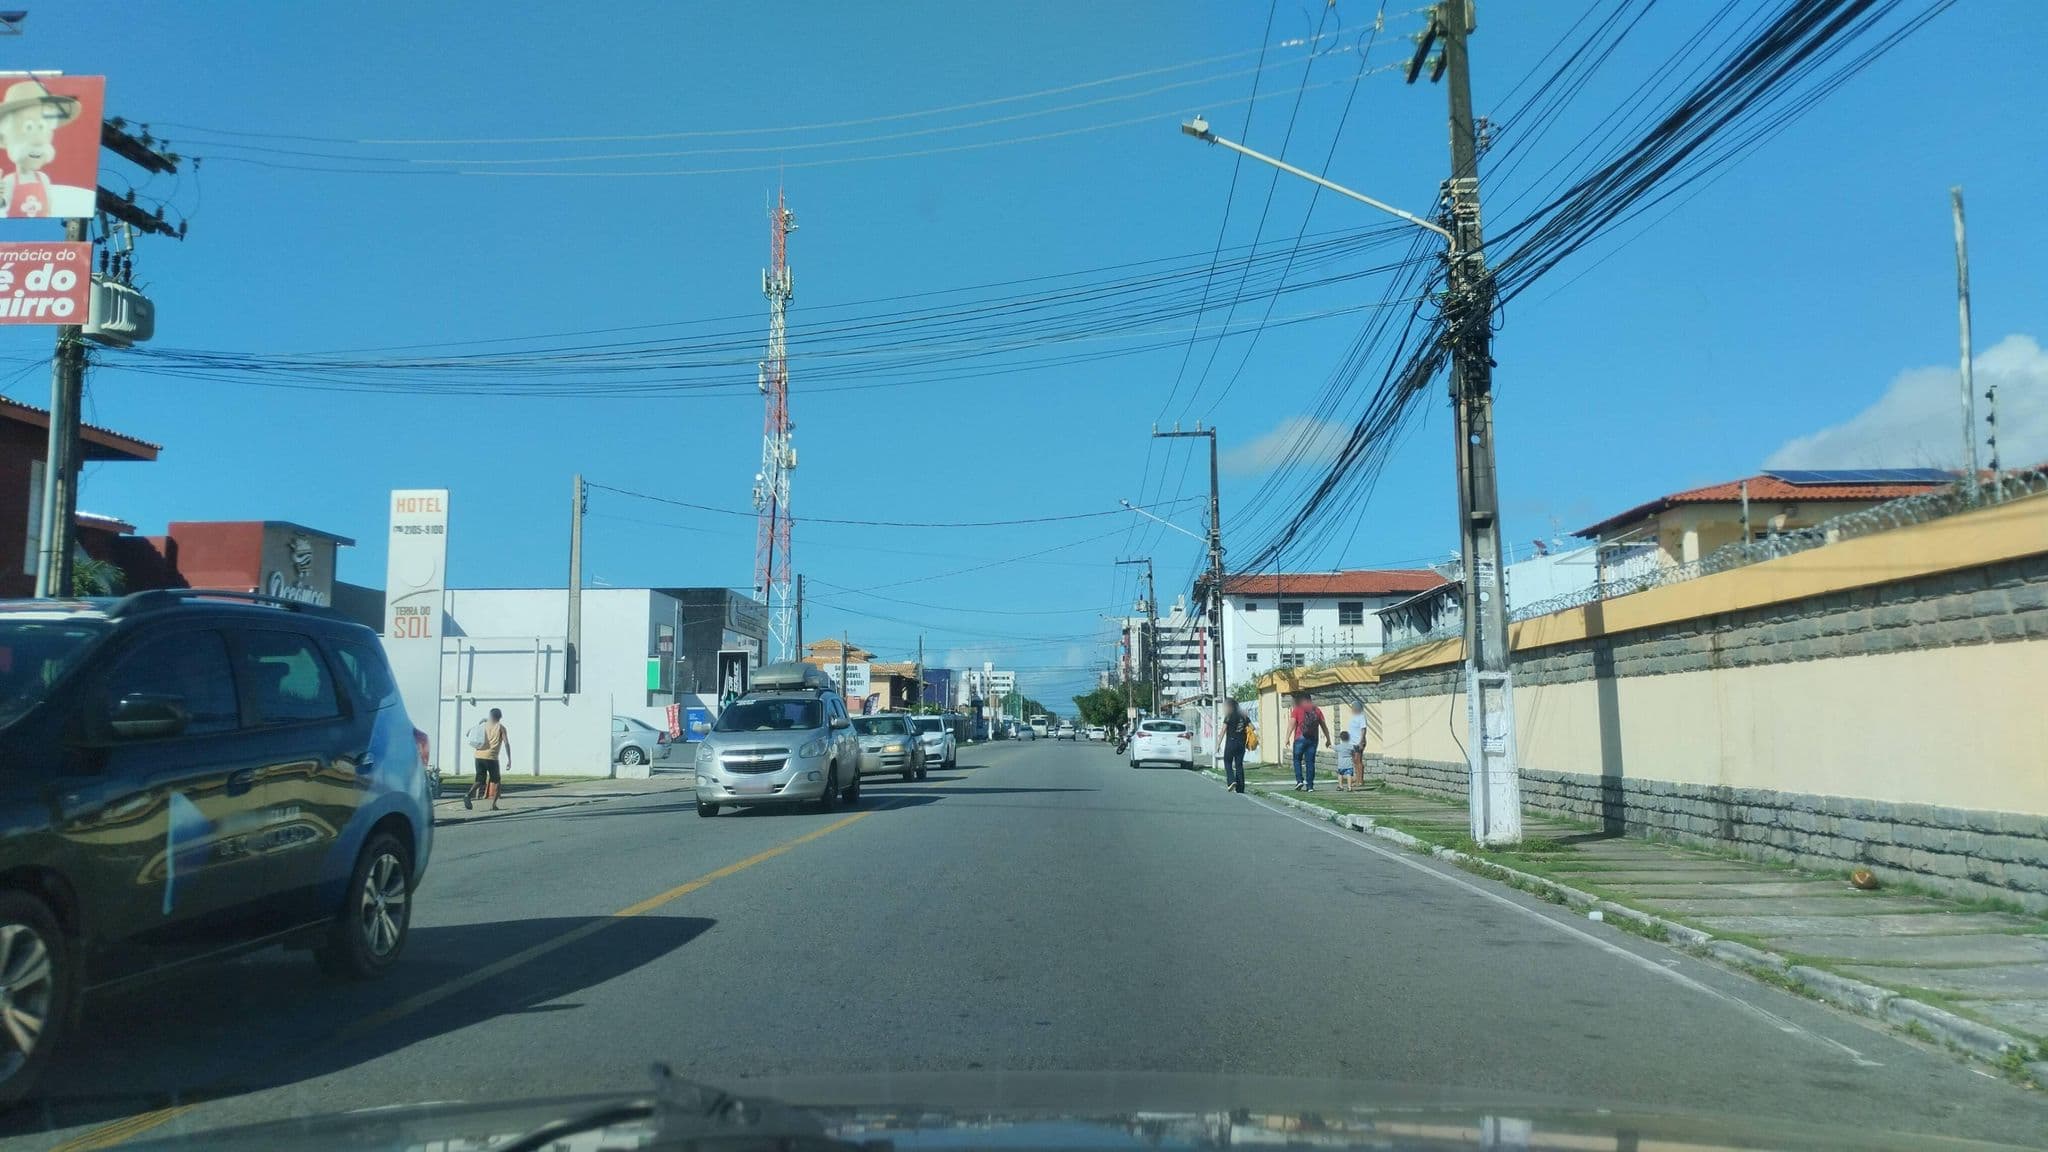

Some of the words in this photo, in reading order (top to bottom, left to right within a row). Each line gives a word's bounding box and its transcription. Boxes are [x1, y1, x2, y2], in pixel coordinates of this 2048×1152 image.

[56, 248, 76, 261] do
[25, 262, 77, 291] do
[396, 497, 442, 513] HOTEL
[395, 606, 418, 616] TERRA
[420, 606, 431, 616] DO
[394, 616, 432, 639] SOL
